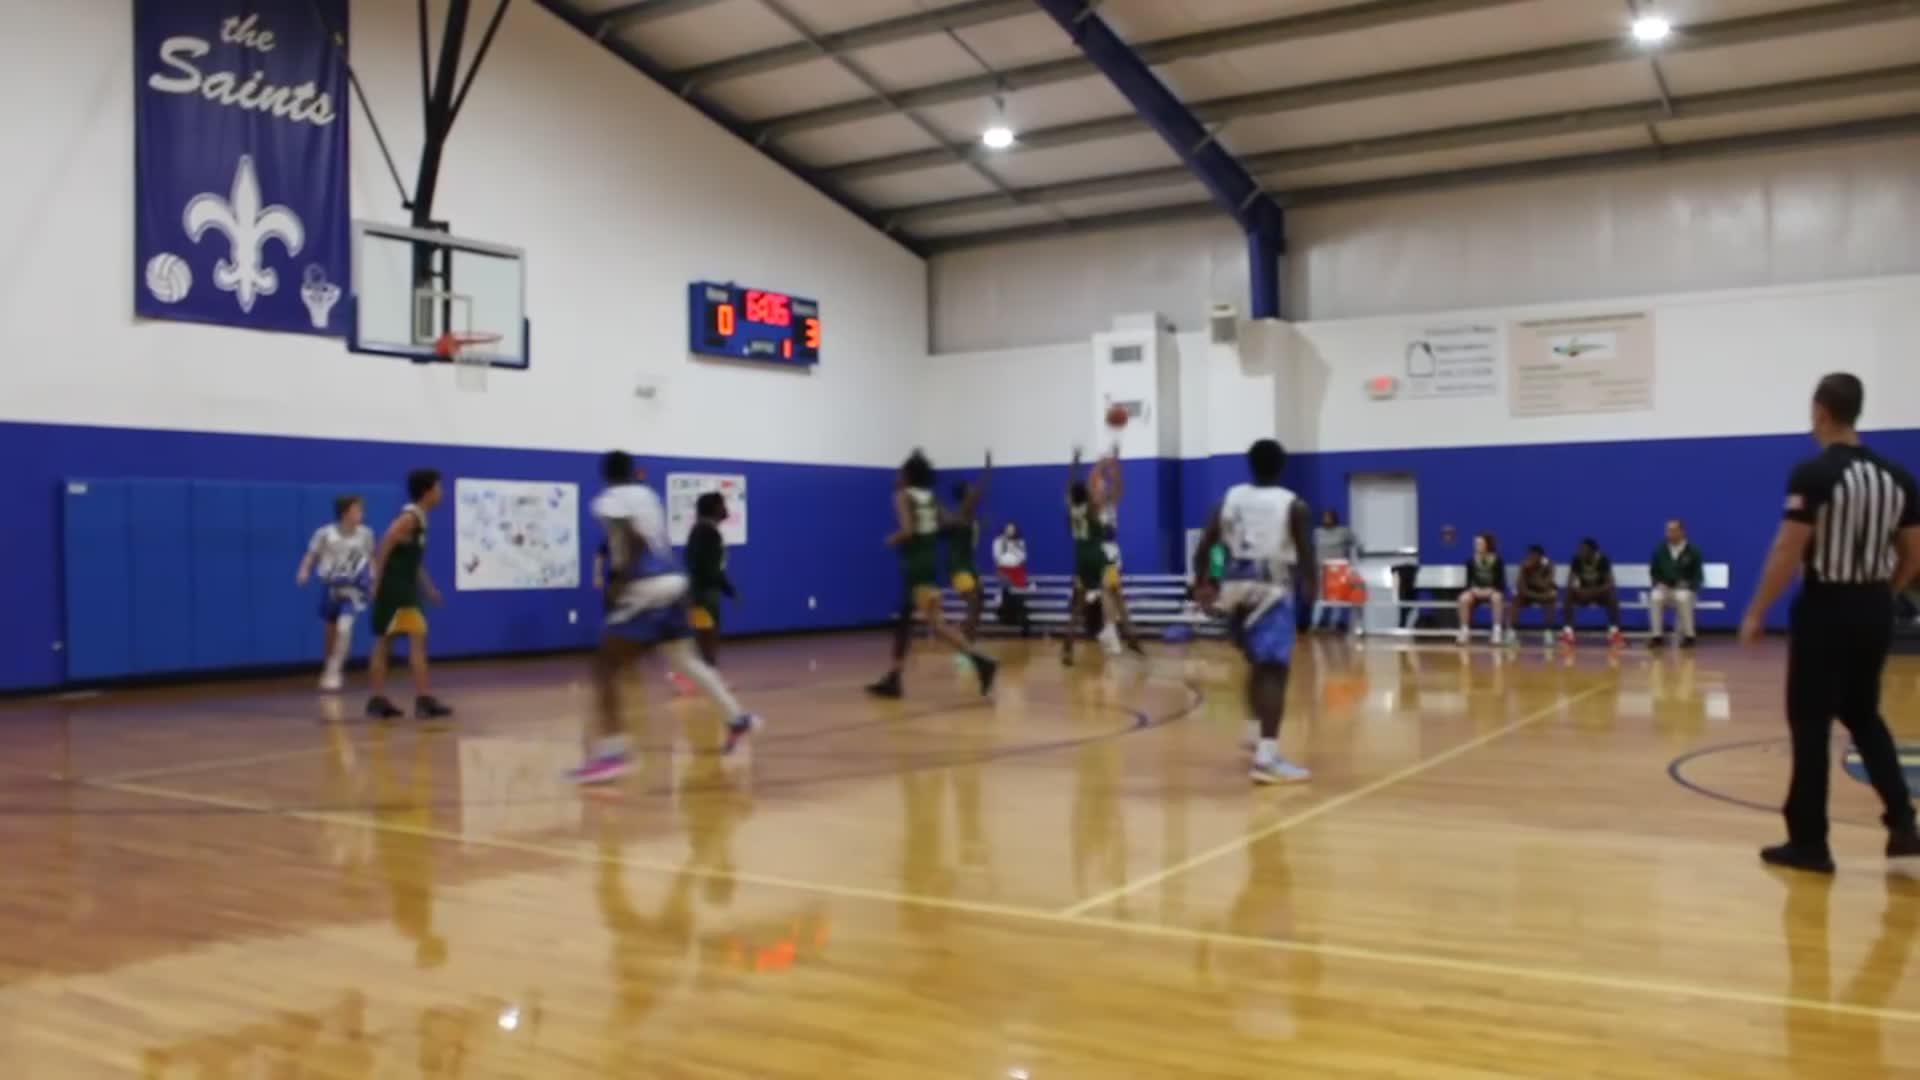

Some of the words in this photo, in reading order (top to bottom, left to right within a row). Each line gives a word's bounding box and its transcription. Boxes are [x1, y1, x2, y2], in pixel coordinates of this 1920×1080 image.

[221, 13, 276, 52] the
[148, 36, 336, 125] Saints
[718, 305, 734, 335] 0
[805, 318, 819, 348] 3
